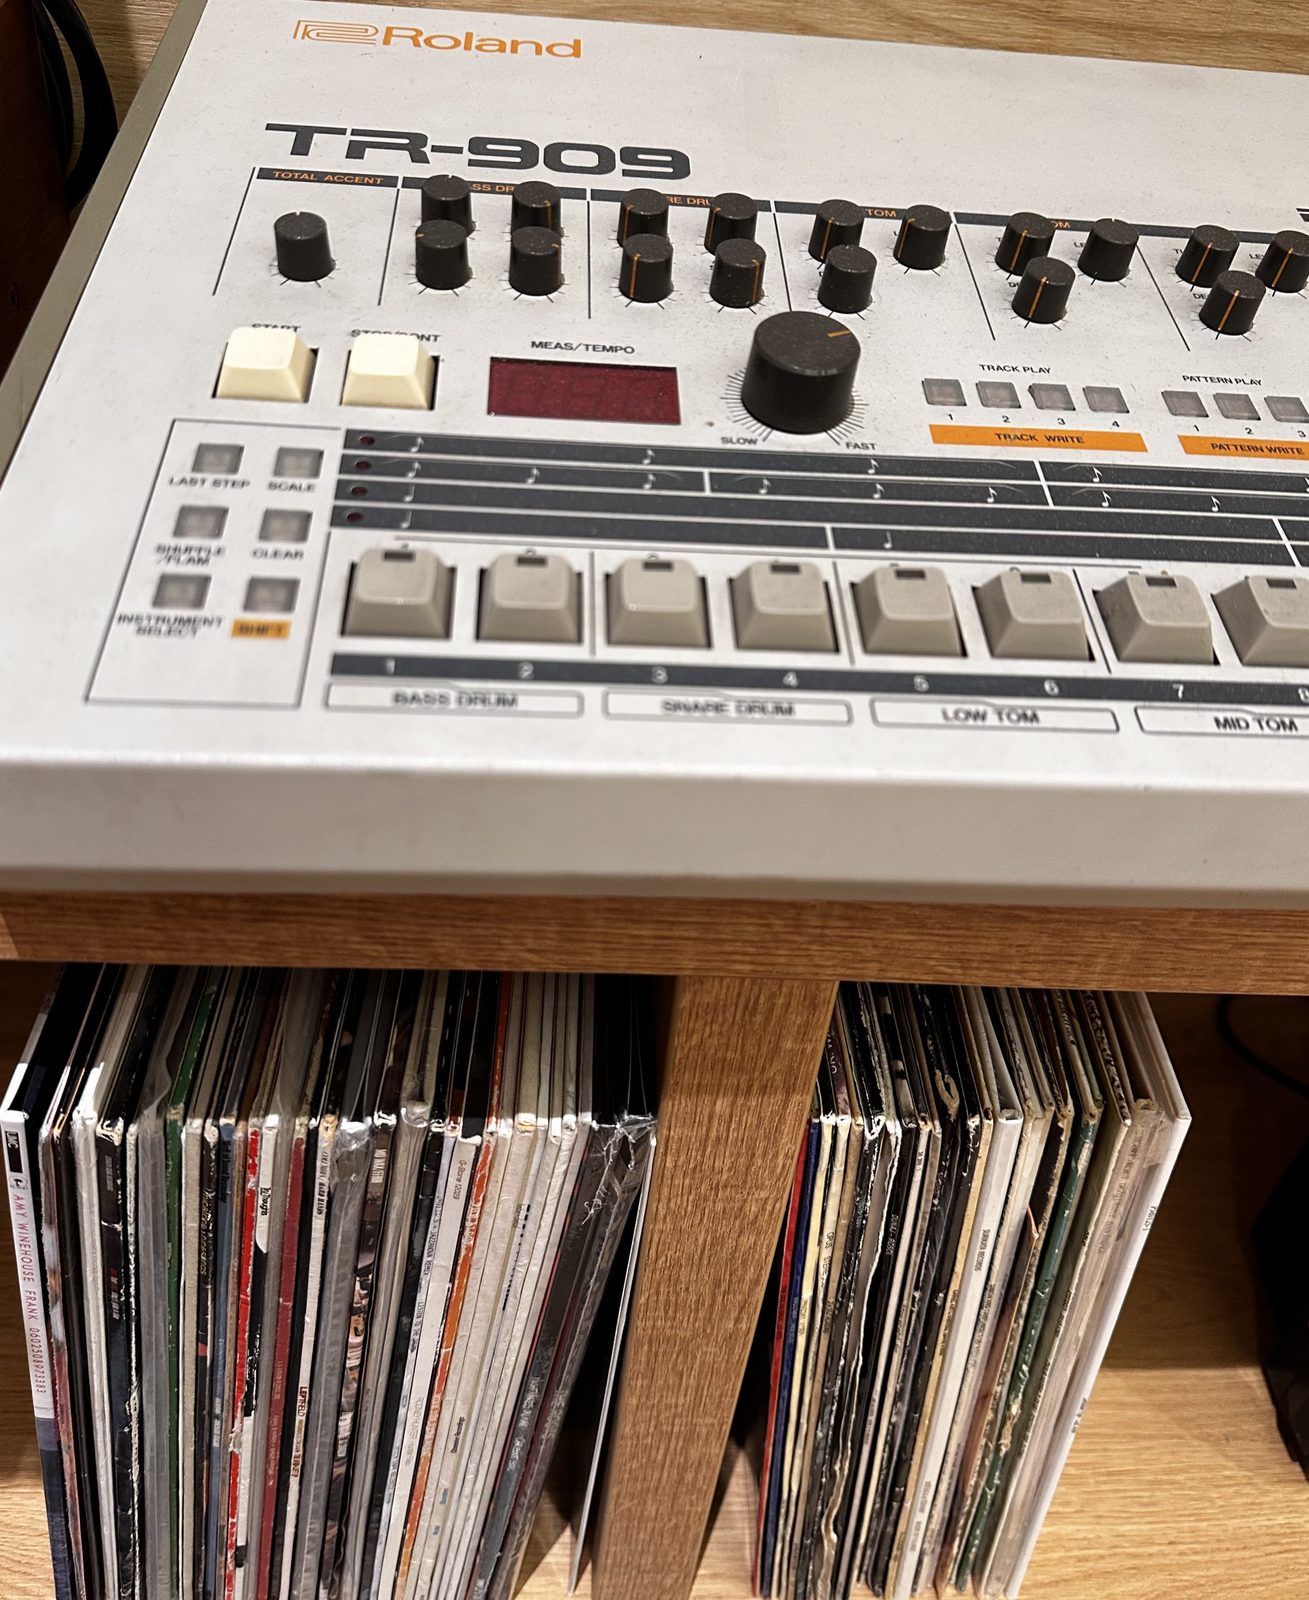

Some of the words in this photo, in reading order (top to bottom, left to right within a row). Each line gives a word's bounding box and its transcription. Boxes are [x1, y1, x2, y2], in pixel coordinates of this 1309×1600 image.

[382, 26, 581, 58] Roland
[265, 123, 691, 180] TR-909
[273, 170, 318, 181] TOTAL
[324, 174, 384, 184] ACCENT
[866, 208, 897, 218] TOM
[531, 340, 635, 355] MEAS/TEMPO
[979, 364, 1020, 374] TRACK
[1022, 366, 1052, 374] PLAY
[1182, 375, 1233, 385] PATTERN
[1234, 378, 1263, 387] PLAY
[947, 413, 954, 421] 1
[1002, 415, 1011, 424] 2
[1057, 418, 1066, 426] 3
[1112, 420, 1120, 428] 4
[994, 432, 1038, 443] TRACK
[1044, 435, 1086, 444] WRITE
[1194, 425, 1200, 433] 1
[1245, 427, 1254, 436] 2
[1297, 430, 1307, 438] 3
[721, 436, 758, 447] SLOW
[846, 441, 878, 451] FAST
[1210, 442, 1264, 454] PATTERN
[1265, 445, 1304, 456] WRITE
[169, 476, 206, 488] LAST
[212, 478, 251, 489] STEP
[267, 482, 316, 493] SCALE
[155, 544, 227, 557] SHUFFLE
[252, 549, 304, 560] CLEAR
[117, 614, 224, 628] INSTRUMENT
[136, 626, 198, 638] SELECT
[238, 624, 284, 634] SHIFT
[386, 658, 396, 675] 1
[518, 662, 534, 679] 2
[652, 666, 668, 684] 3
[782, 671, 798, 688] 4
[914, 675, 930, 692] 5
[1044, 679, 1060, 696] 6
[1172, 684, 1184, 700] 7
[393, 690, 451, 706] BASS
[457, 691, 520, 708] DRUM
[661, 699, 730, 714] SNARE
[736, 700, 796, 716] DRUM
[941, 706, 988, 723] LOW
[994, 708, 1040, 724] TOM
[1213, 716, 1250, 730] MID
[1252, 716, 1298, 732] TOM
[13, 1193, 26, 1216] AMY
[17, 1222, 34, 1281] WINEHOUSE
[974, 1250, 984, 1272] RECORDS
[25, 1290, 38, 1319] FRANK
